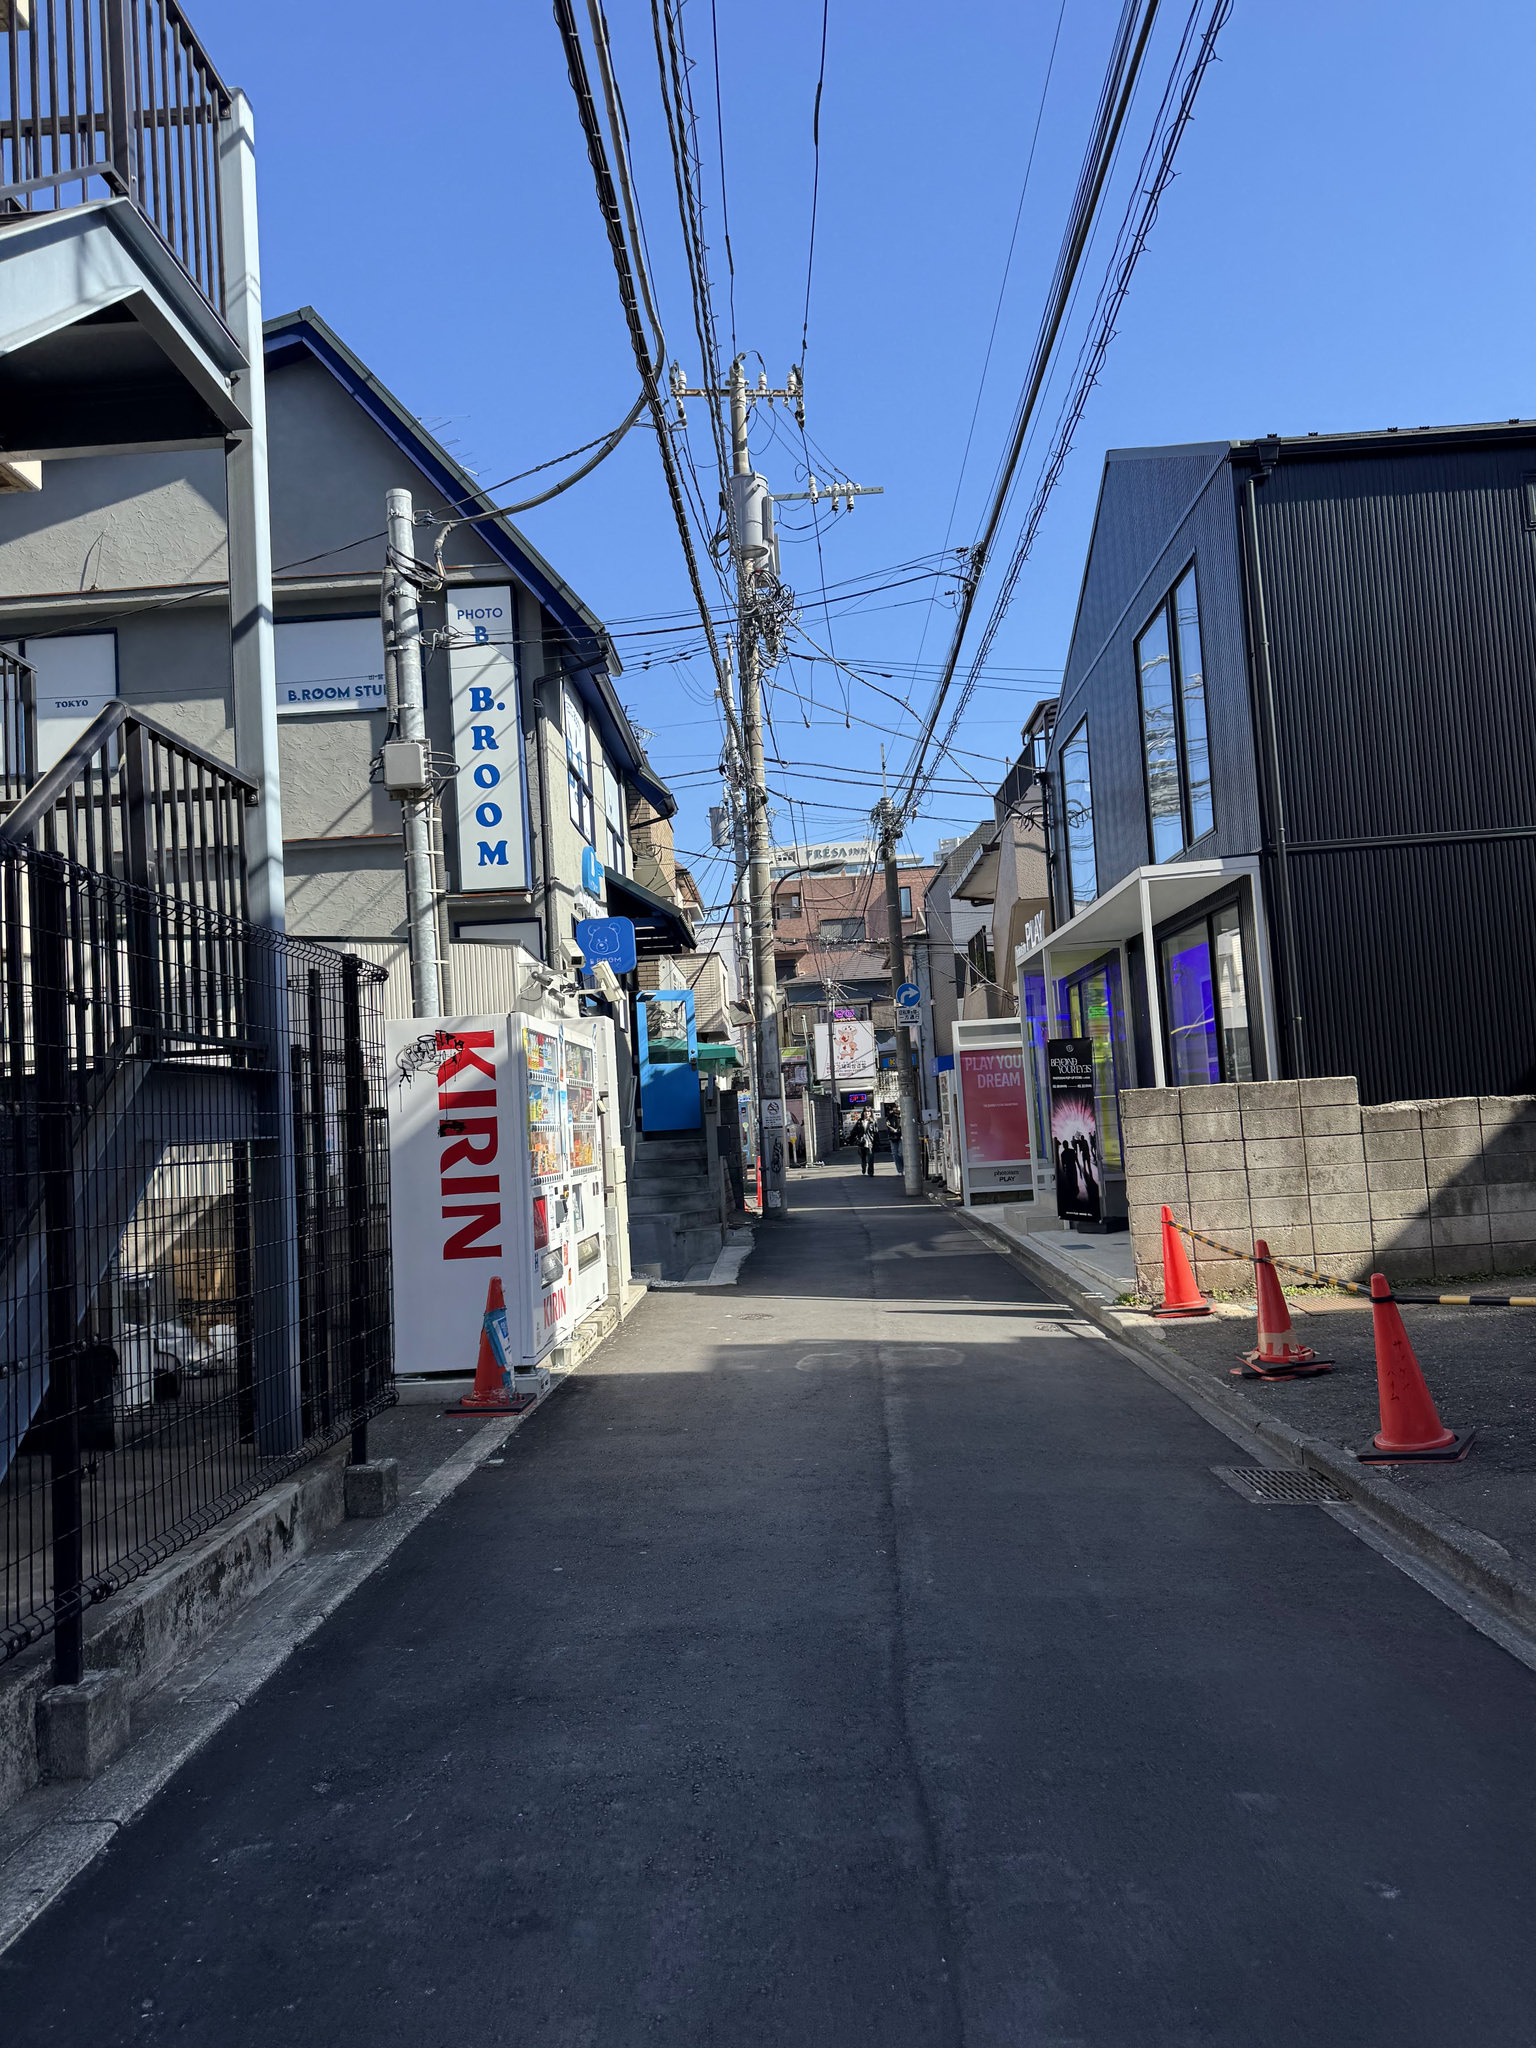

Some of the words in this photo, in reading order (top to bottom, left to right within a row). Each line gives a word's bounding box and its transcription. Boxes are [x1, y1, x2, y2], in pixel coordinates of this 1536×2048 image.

[457, 607, 503, 620] PHOTO
[288, 686, 350, 701] B.ROOM
[355, 684, 387, 697] STU
[55, 699, 88, 708] TOKYO
[806, 846, 847, 860] FRÉSA
[848, 847, 868, 856] INN
[1024, 909, 1045, 952] PLAY
[965, 1056, 994, 1071] PLAY
[996, 1054, 1023, 1069] YOU
[1050, 1057, 1078, 1067] BEYOND
[977, 1072, 1021, 1089] DREAM
[436, 1029, 502, 1260] KIRIN
[543, 1286, 568, 1329] KIRIN
